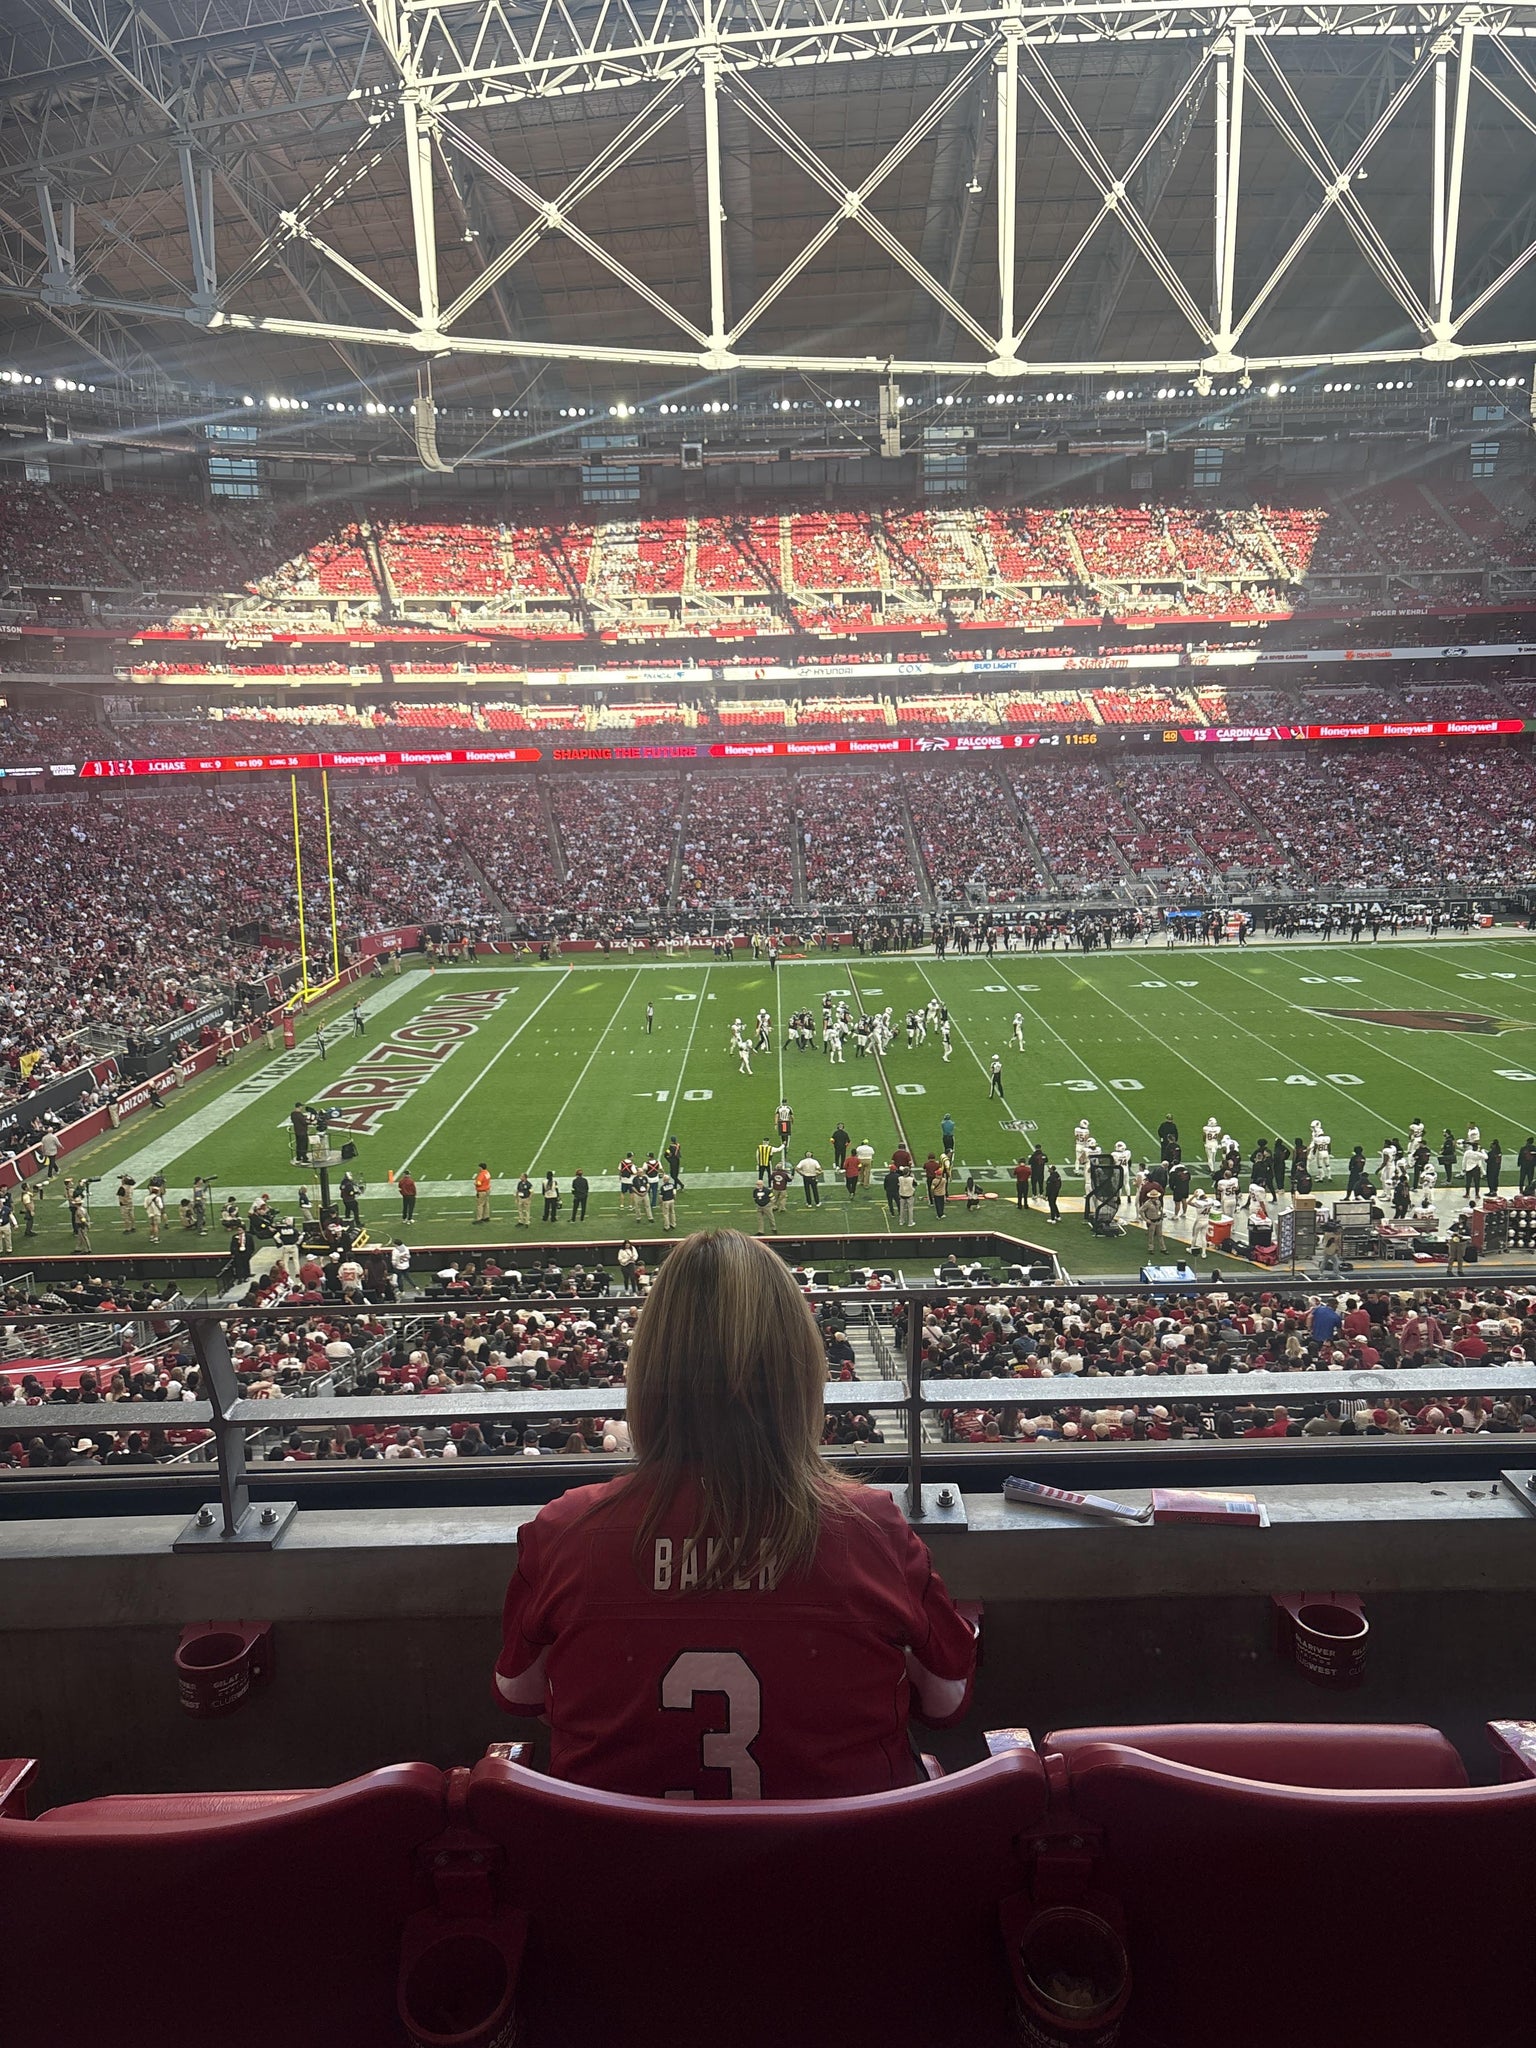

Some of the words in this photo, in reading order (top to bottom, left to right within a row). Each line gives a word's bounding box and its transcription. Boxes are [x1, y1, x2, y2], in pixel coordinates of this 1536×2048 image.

[1371, 609, 1397, 617] ROGER
[1399, 608, 1428, 616] WEHRLI
[1014, 620, 1028, 628] PAT
[1031, 619, 1064, 627] TILLMAN
[813, 667, 853, 675] HYUNDAI
[898, 664, 922, 673] COX
[993, 661, 1018, 670] LIGHT
[1320, 726, 1369, 737] Honeywell
[1384, 724, 1433, 735] Honeywell
[1447, 722, 1498, 733] Honeywell
[1051, 735, 1059, 745] 2
[1065, 734, 1097, 745] 11:56
[1194, 730, 1207, 741] 13
[1216, 728, 1271, 738] CARDINALS
[850, 741, 899, 752] Honeywell
[957, 736, 1001, 747] FALCONS
[1014, 736, 1023, 747] 9
[553, 748, 612, 760] SHAPING
[613, 747, 640, 759] THE
[643, 746, 697, 758] FUTURE
[724, 744, 774, 756] Honeywell
[787, 743, 836, 754] Honeywell
[333, 753, 387, 765] Honeywell
[401, 752, 452, 764] Honeywell
[465, 750, 516, 762] Honeywell
[148, 761, 186, 771] J.CHASE
[215, 760, 222, 769] 9
[249, 759, 263, 767] 109
[287, 757, 298, 766] 36
[169, 1021, 195, 1042] ARIZONA
[195, 1007, 225, 1028] CARDINALS
[250, 1050, 317, 1082] TAKES
[277, 986, 520, 1136] ARIZONA
[233, 1083, 269, 1094] IT
[118, 1088, 151, 1116] ARIZON
[1207, 1133, 1218, 1141] 84
[1202, 1418, 1215, 1431] 31
[653, 1536, 777, 1591] BAKER
[661, 1651, 761, 1800] 3
